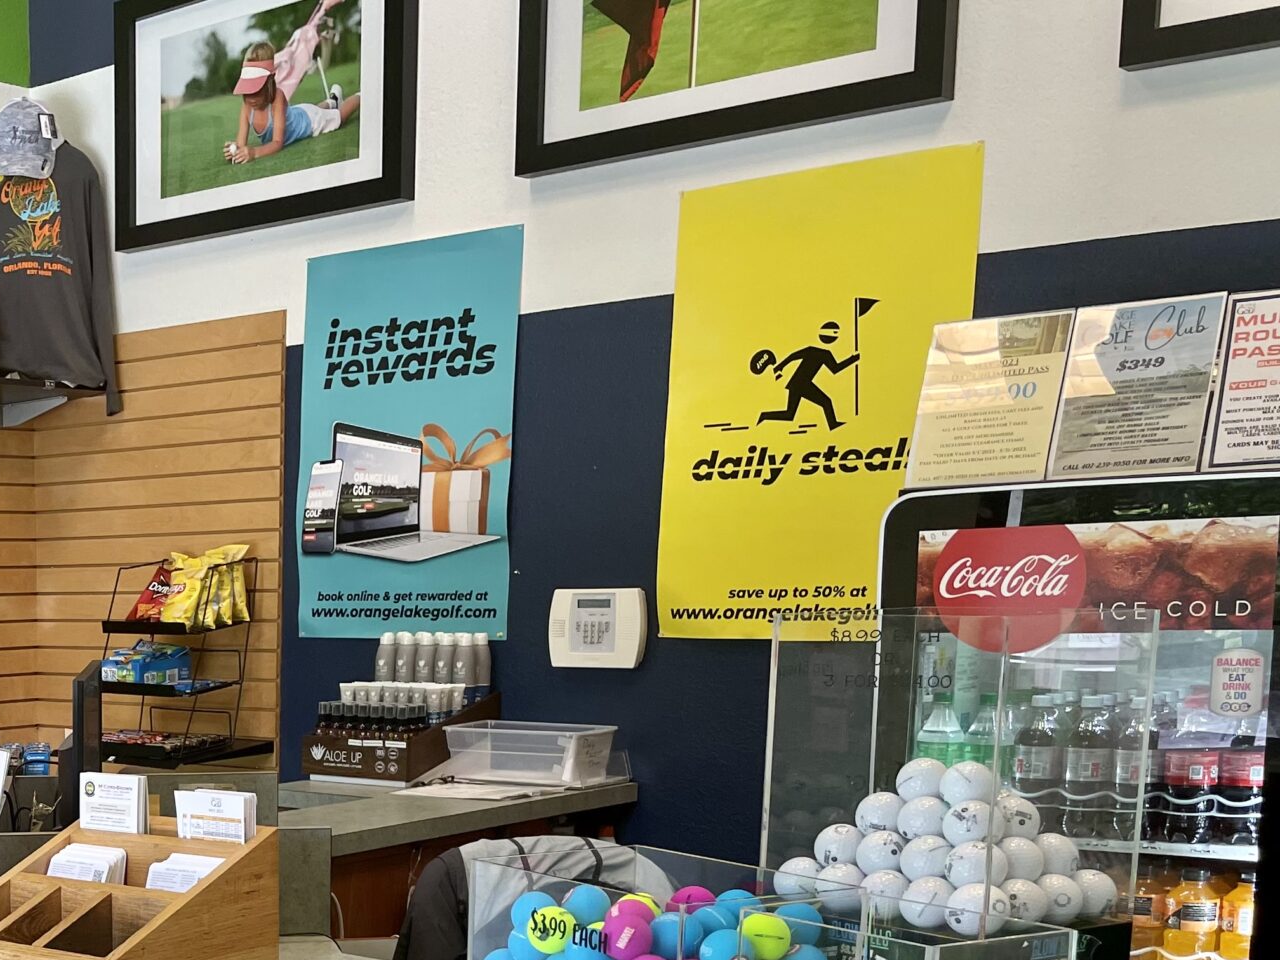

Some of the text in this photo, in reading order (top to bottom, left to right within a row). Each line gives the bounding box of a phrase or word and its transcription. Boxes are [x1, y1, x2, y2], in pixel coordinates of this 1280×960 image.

[22, 191, 61, 221] Lake
[3, 261, 41, 274] ORLANDO,
[324, 308, 476, 359] instant
[1144, 305, 1209, 351] Club
[323, 337, 497, 390] rewards
[1027, 365, 1050, 375] PASS
[1116, 356, 1165, 372] $349
[691, 437, 910, 486] daily steal
[352, 485, 373, 496] GOLF
[939, 553, 1079, 600] Coca-Cola
[317, 589, 488, 606] book online & get rewarded at
[728, 585, 868, 602] save up to 50% at
[311, 604, 497, 621] www.orangelakegolf.com
[1098, 599, 1253, 621] ICE COLD
[1216, 657, 1261, 668] BALANCE
[823, 674, 878, 688] 3 FOR
[1222, 681, 1252, 692] DRINK
[1227, 673, 1246, 683] EAT
[1233, 691, 1247, 701] DO
[323, 750, 363, 764] ALOE UP
[572, 923, 609, 955] EACH
